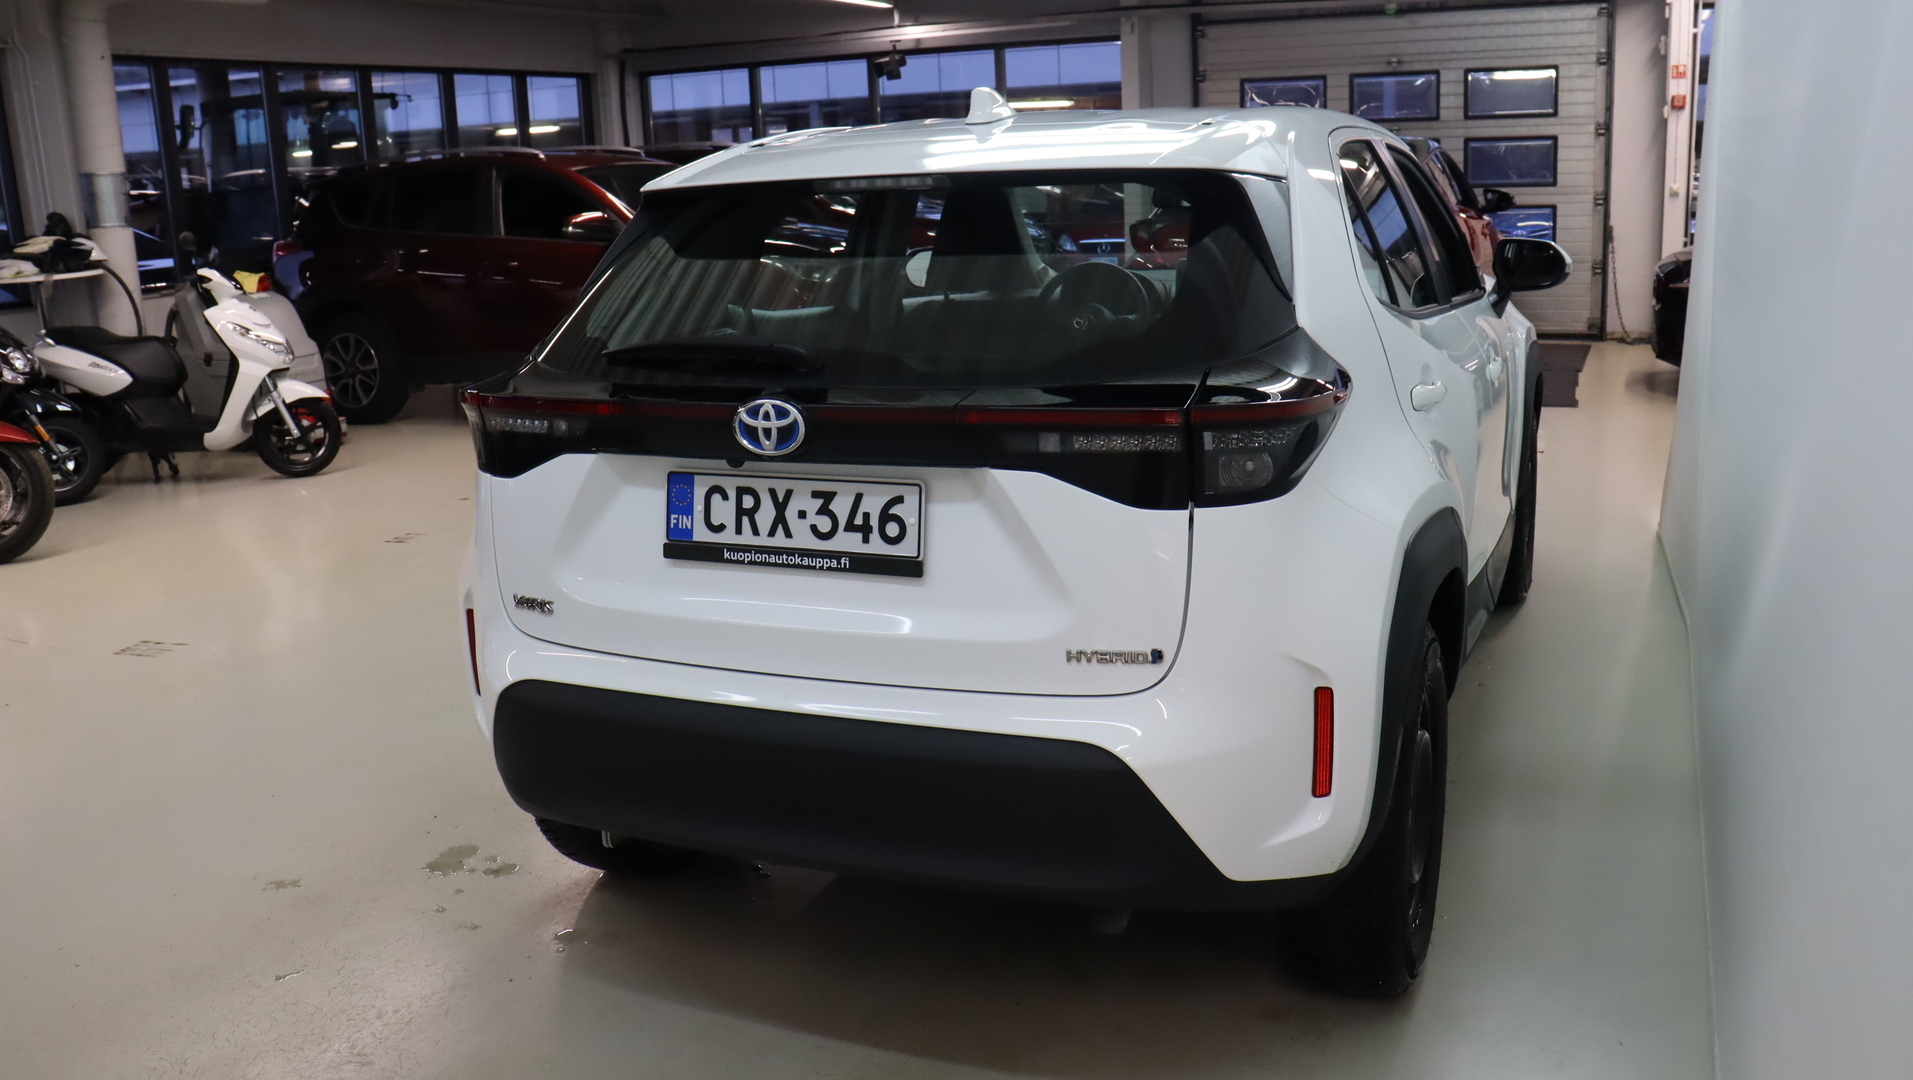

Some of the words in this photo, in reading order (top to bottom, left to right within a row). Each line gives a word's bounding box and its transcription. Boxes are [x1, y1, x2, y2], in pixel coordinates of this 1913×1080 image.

[670, 514, 692, 529] FIN
[723, 548, 850, 569] kuopionautokauppa.fi
[1066, 648, 1149, 664] HYBRID
